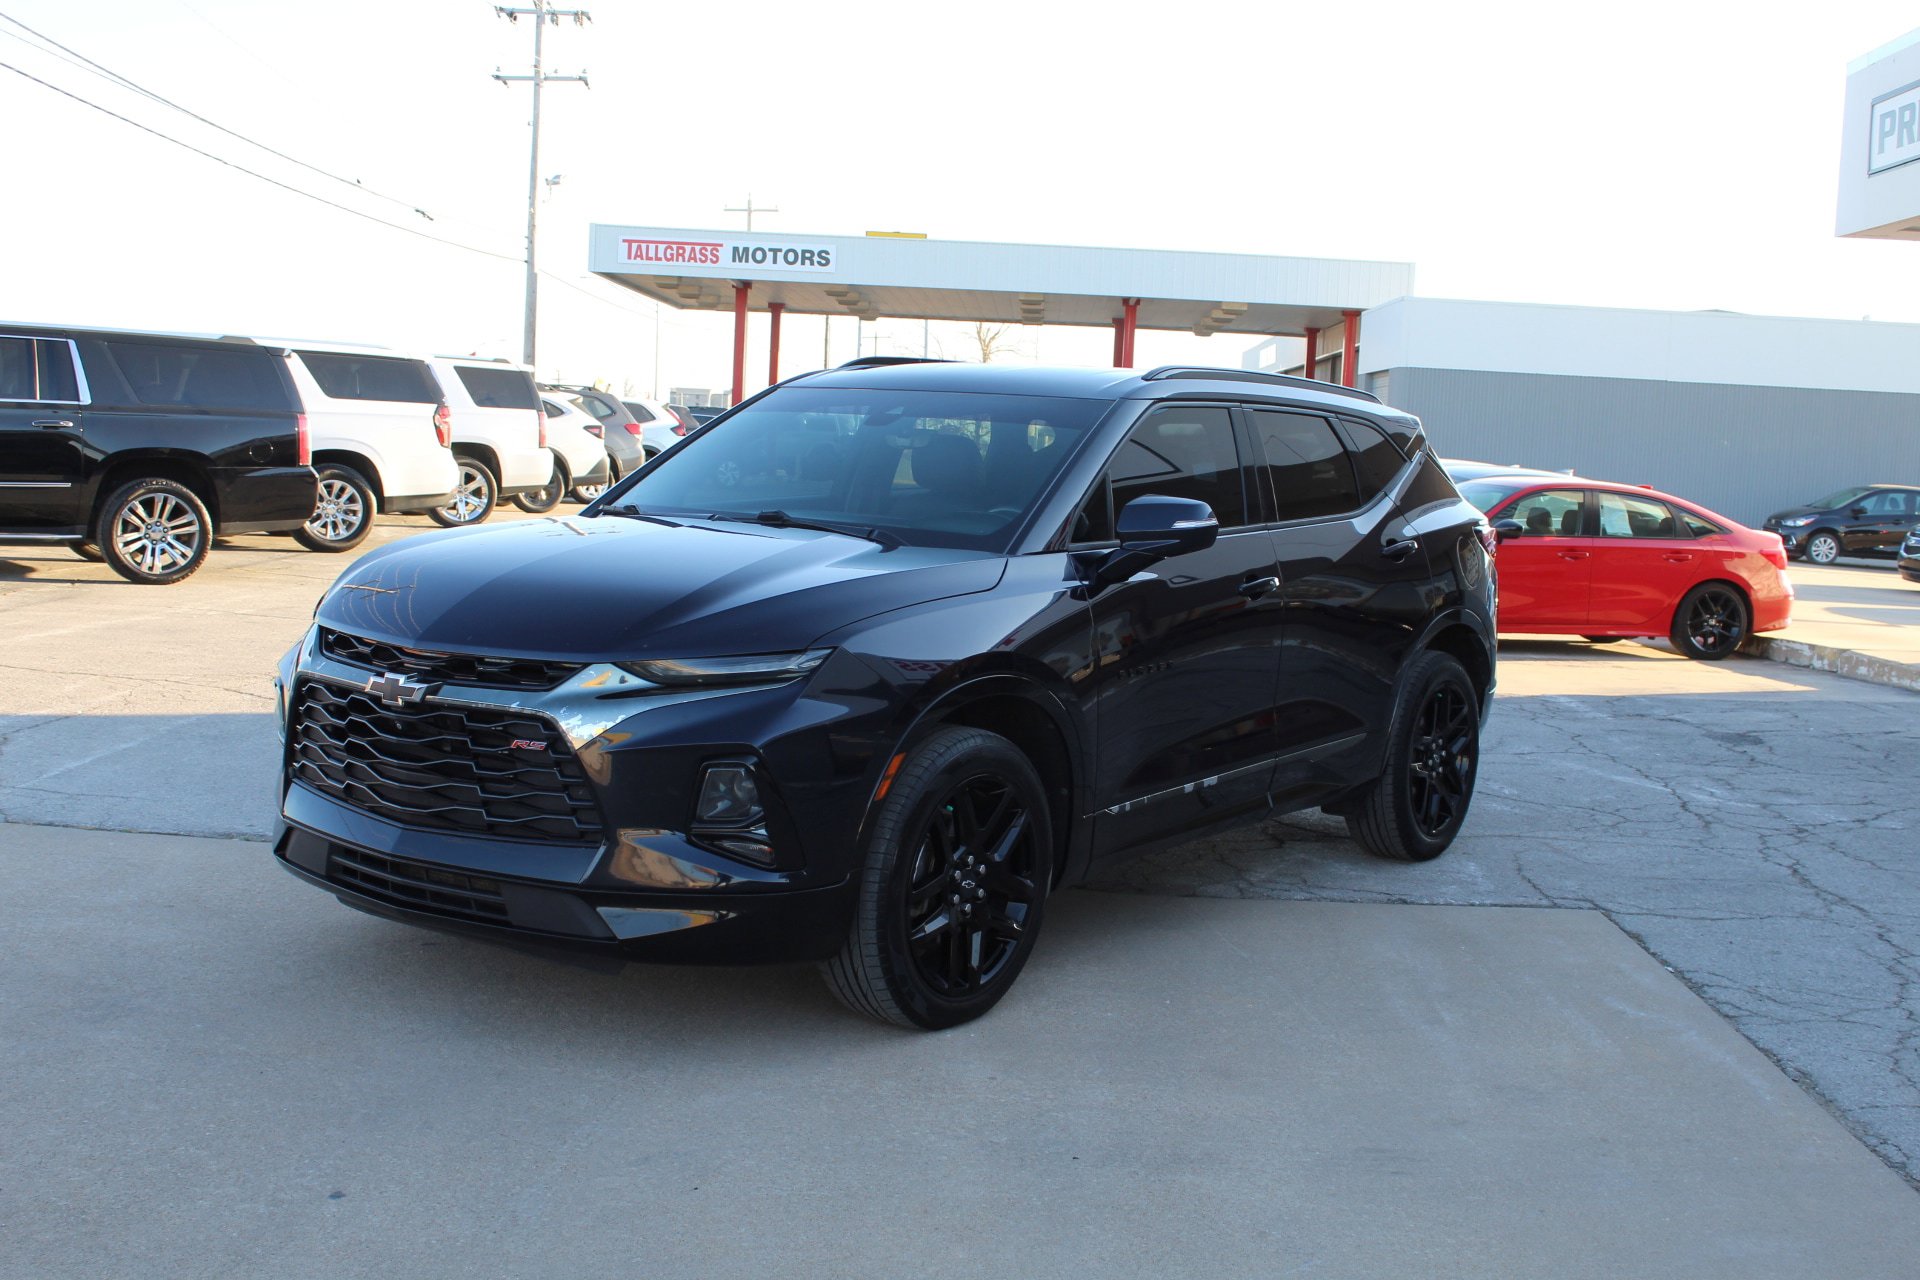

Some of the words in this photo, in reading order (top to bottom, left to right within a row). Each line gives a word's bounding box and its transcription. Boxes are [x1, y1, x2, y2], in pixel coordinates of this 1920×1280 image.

[1877, 100, 1920, 155] PR
[622, 239, 723, 264] TALLGRASS
[731, 246, 831, 267] MOTORS
[511, 739, 547, 750] RS
